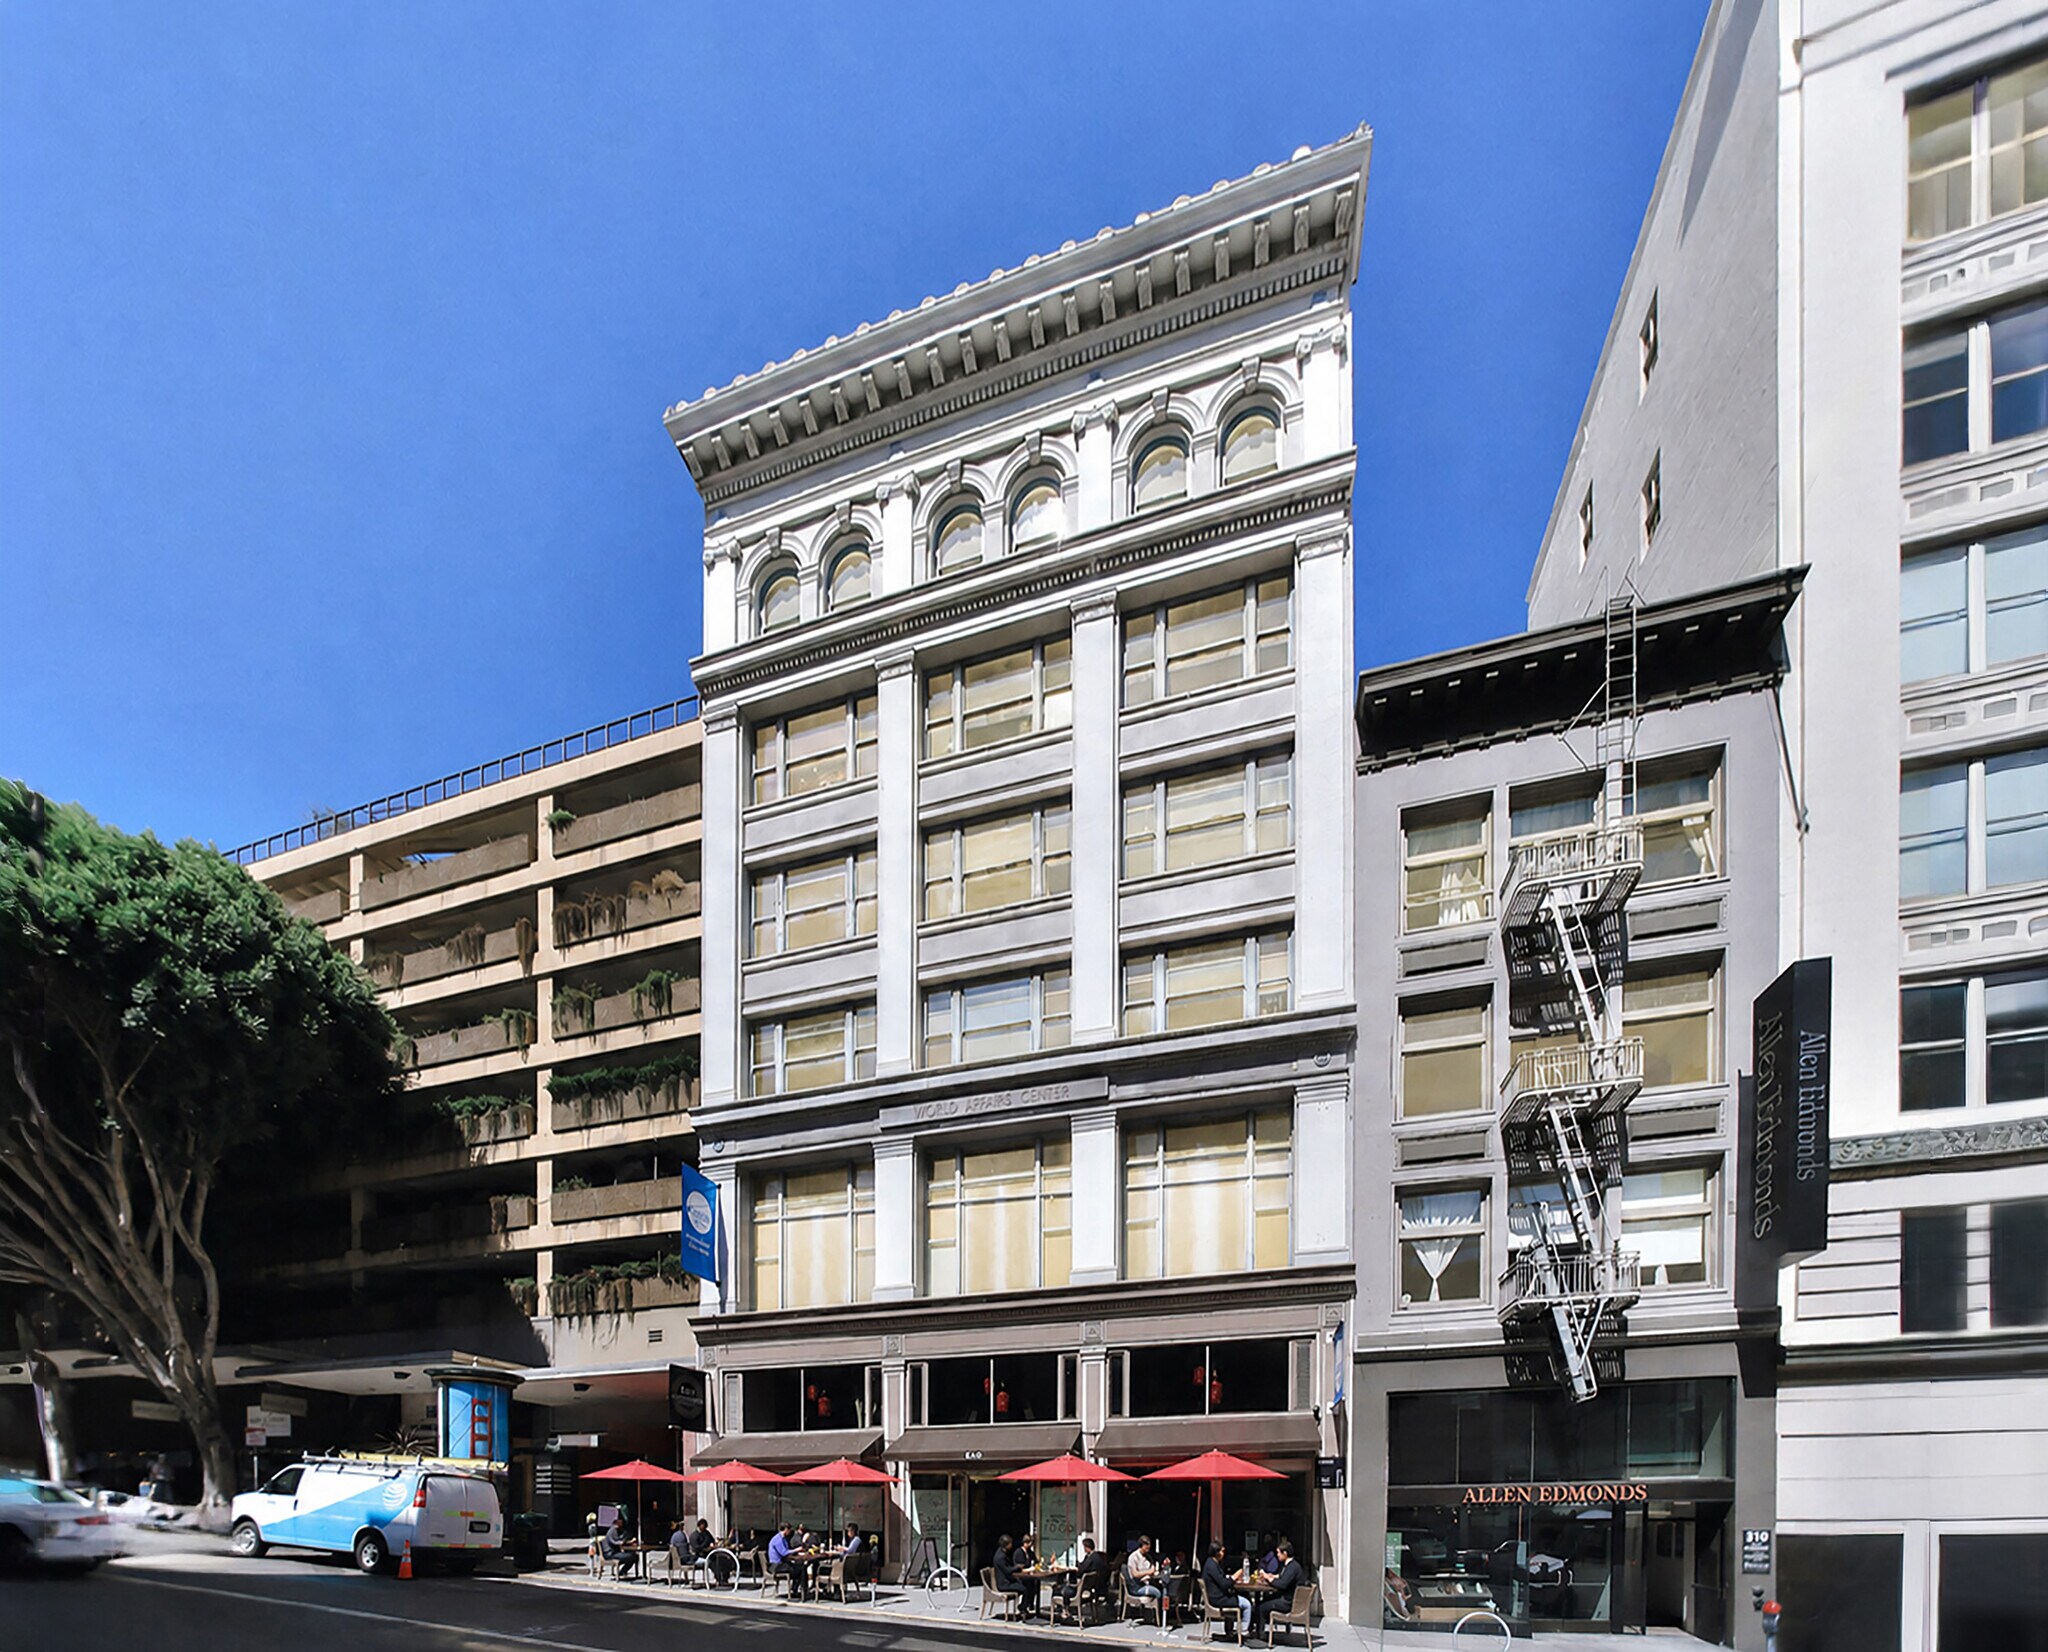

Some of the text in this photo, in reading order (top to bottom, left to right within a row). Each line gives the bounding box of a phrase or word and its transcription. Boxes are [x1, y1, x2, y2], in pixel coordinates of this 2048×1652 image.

[913, 1084, 1070, 1120] WORLD AFFAIRS CENTER
[1796, 1030, 1826, 1182] Allen Edmonds
[1462, 1484, 1648, 1503] ALLEN EDMONDS
[1746, 1530, 1769, 1543] 310
